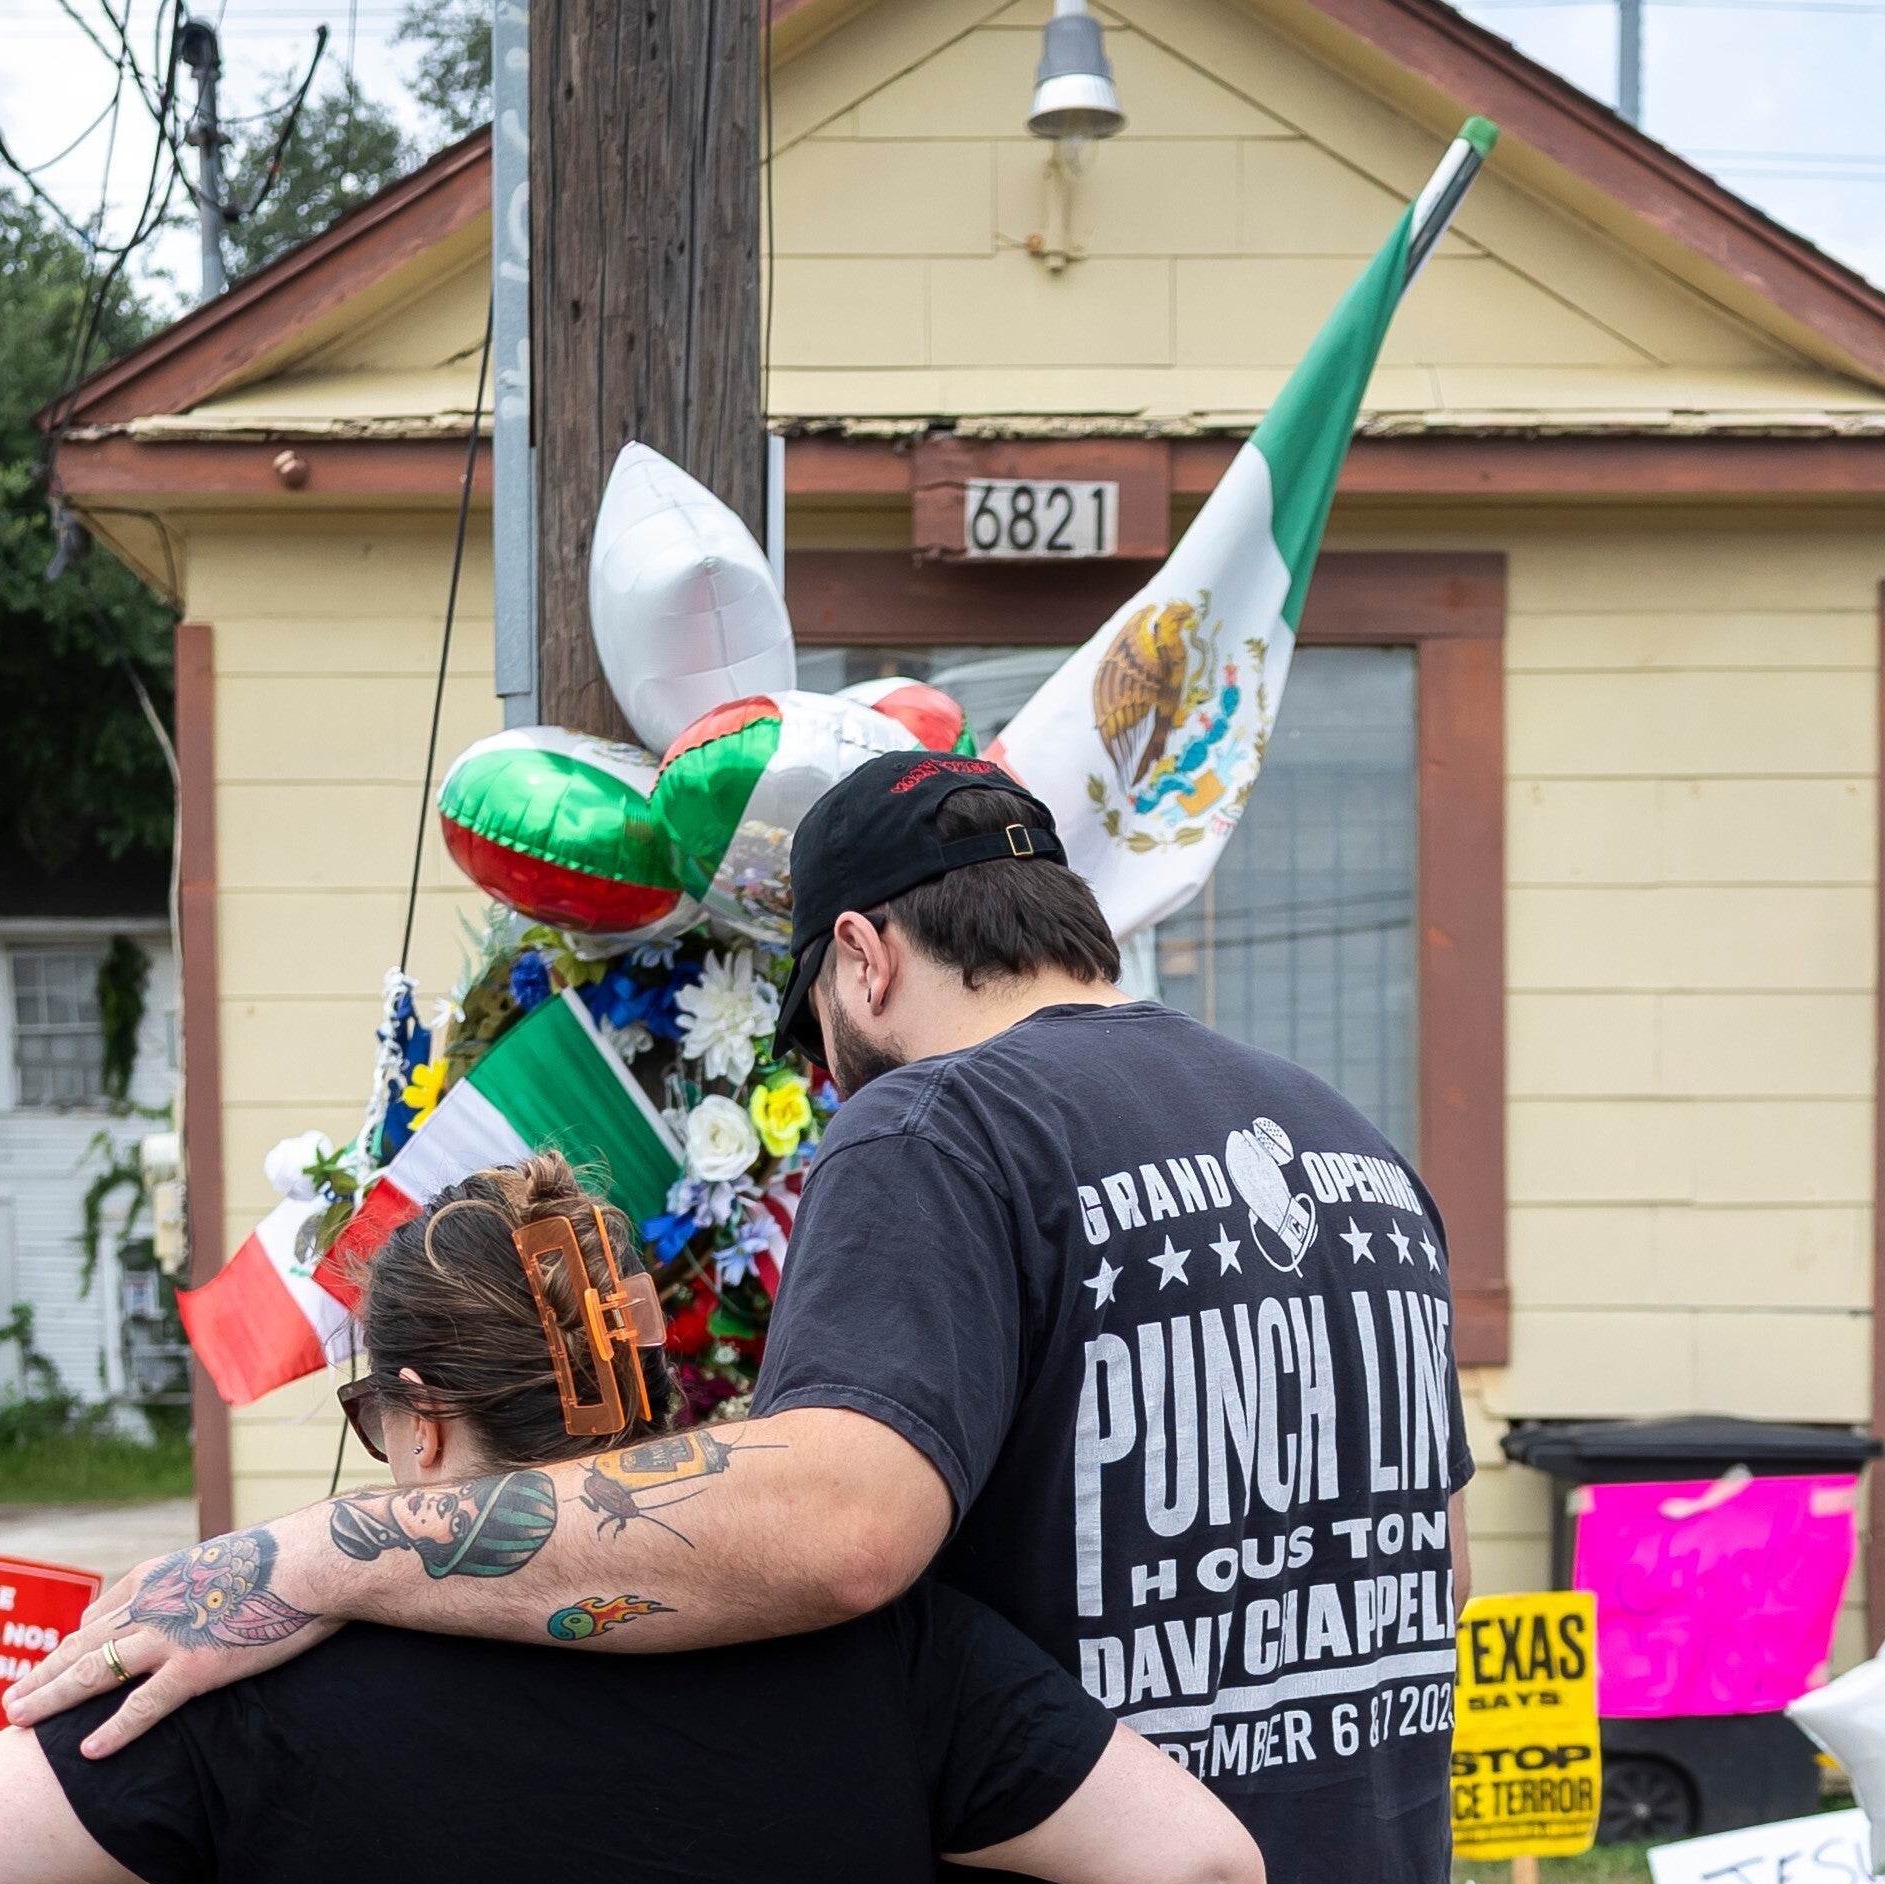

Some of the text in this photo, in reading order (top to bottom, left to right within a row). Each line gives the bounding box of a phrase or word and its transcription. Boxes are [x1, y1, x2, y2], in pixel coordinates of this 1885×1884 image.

[972, 485, 1104, 551] 6821
[1077, 1151, 1423, 1246] GRAND OPENING
[1074, 1295, 1339, 1618] PUNCH
[3, 1621, 61, 1652] NOS
[1468, 1692, 1561, 1710] SAYS
[1331, 1702, 1360, 1756] 6
[1452, 1745, 1591, 1777] STOP
[1454, 1777, 1594, 1821] CE TERROR
